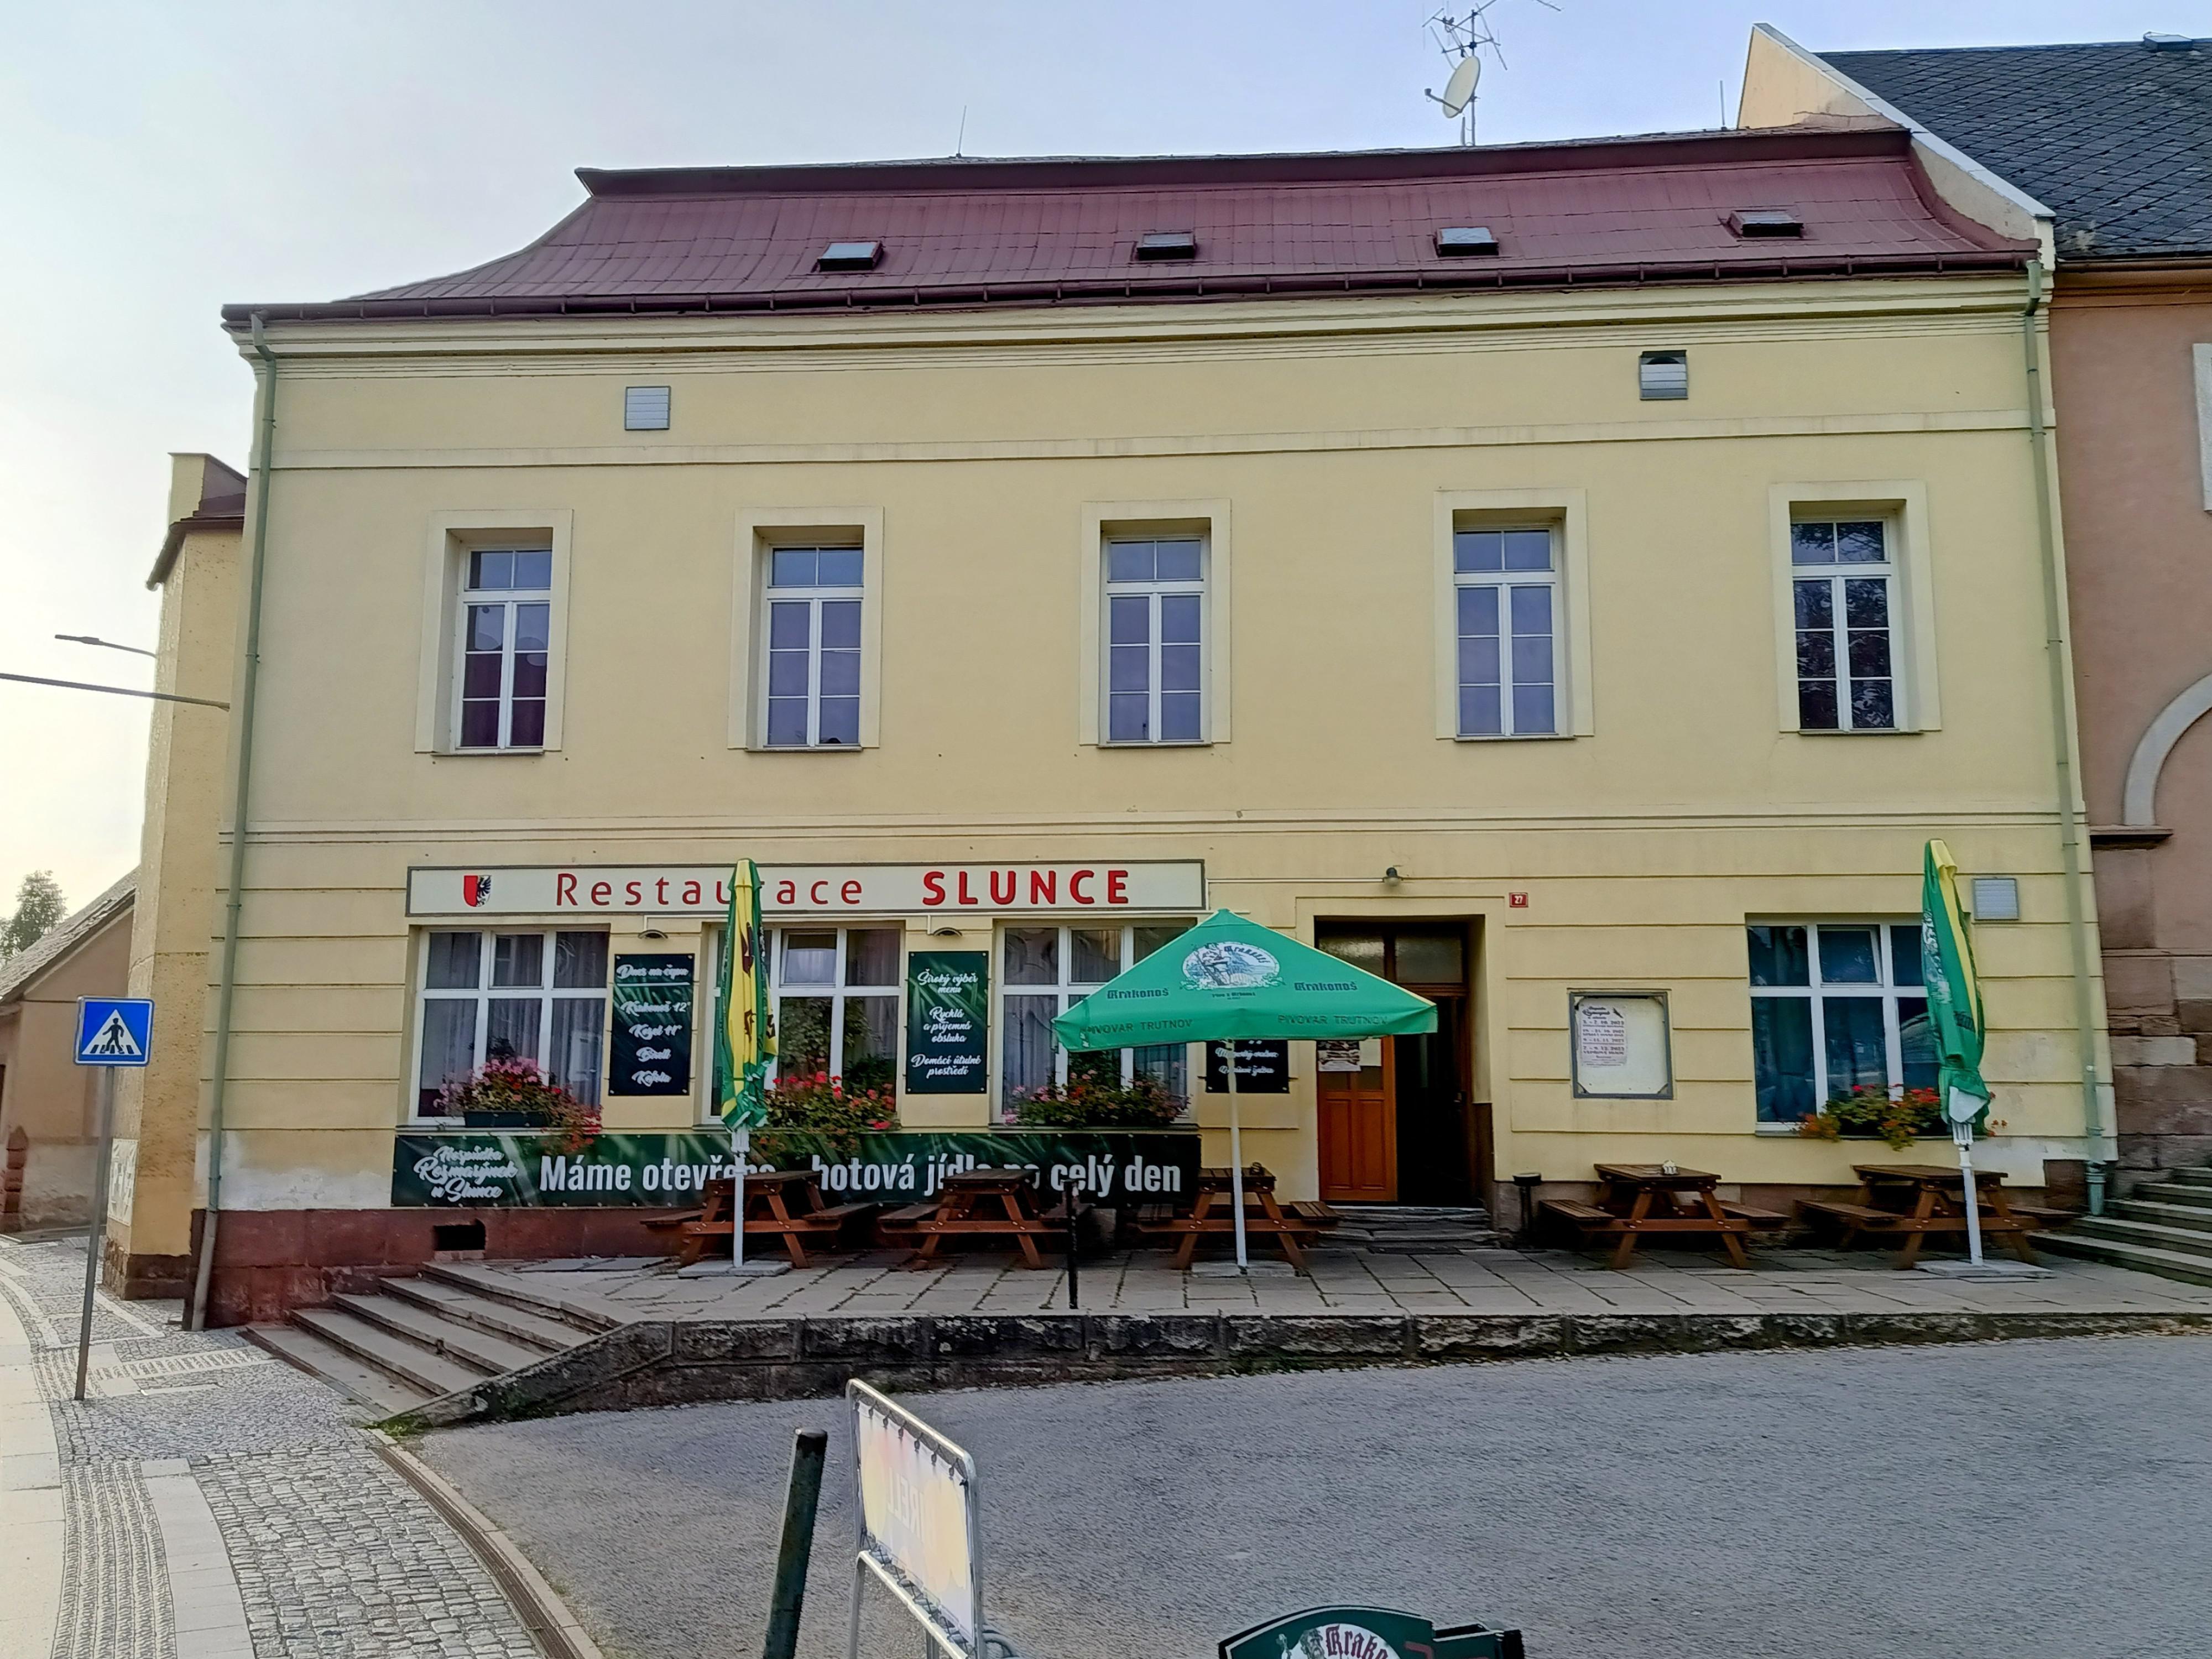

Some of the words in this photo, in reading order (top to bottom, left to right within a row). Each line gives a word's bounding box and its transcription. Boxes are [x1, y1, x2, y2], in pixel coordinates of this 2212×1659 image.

[556, 873, 862, 906] Restauace
[922, 869, 1129, 905] SLUNCE
[917, 968, 951, 987] Široký
[1294, 981, 1358, 991] Krakonoš
[1107, 988, 1169, 999] Krakonoš
[929, 1006, 965, 1024] Rychlá
[1140, 1019, 1193, 1031] TRUTNOV
[539, 1154, 631, 1192] Máme
[811, 1154, 914, 1191] hotová
[1050, 1154, 1114, 1197] celý
[1124, 1154, 1181, 1192] den
[444, 1177, 503, 1202] Slunce
